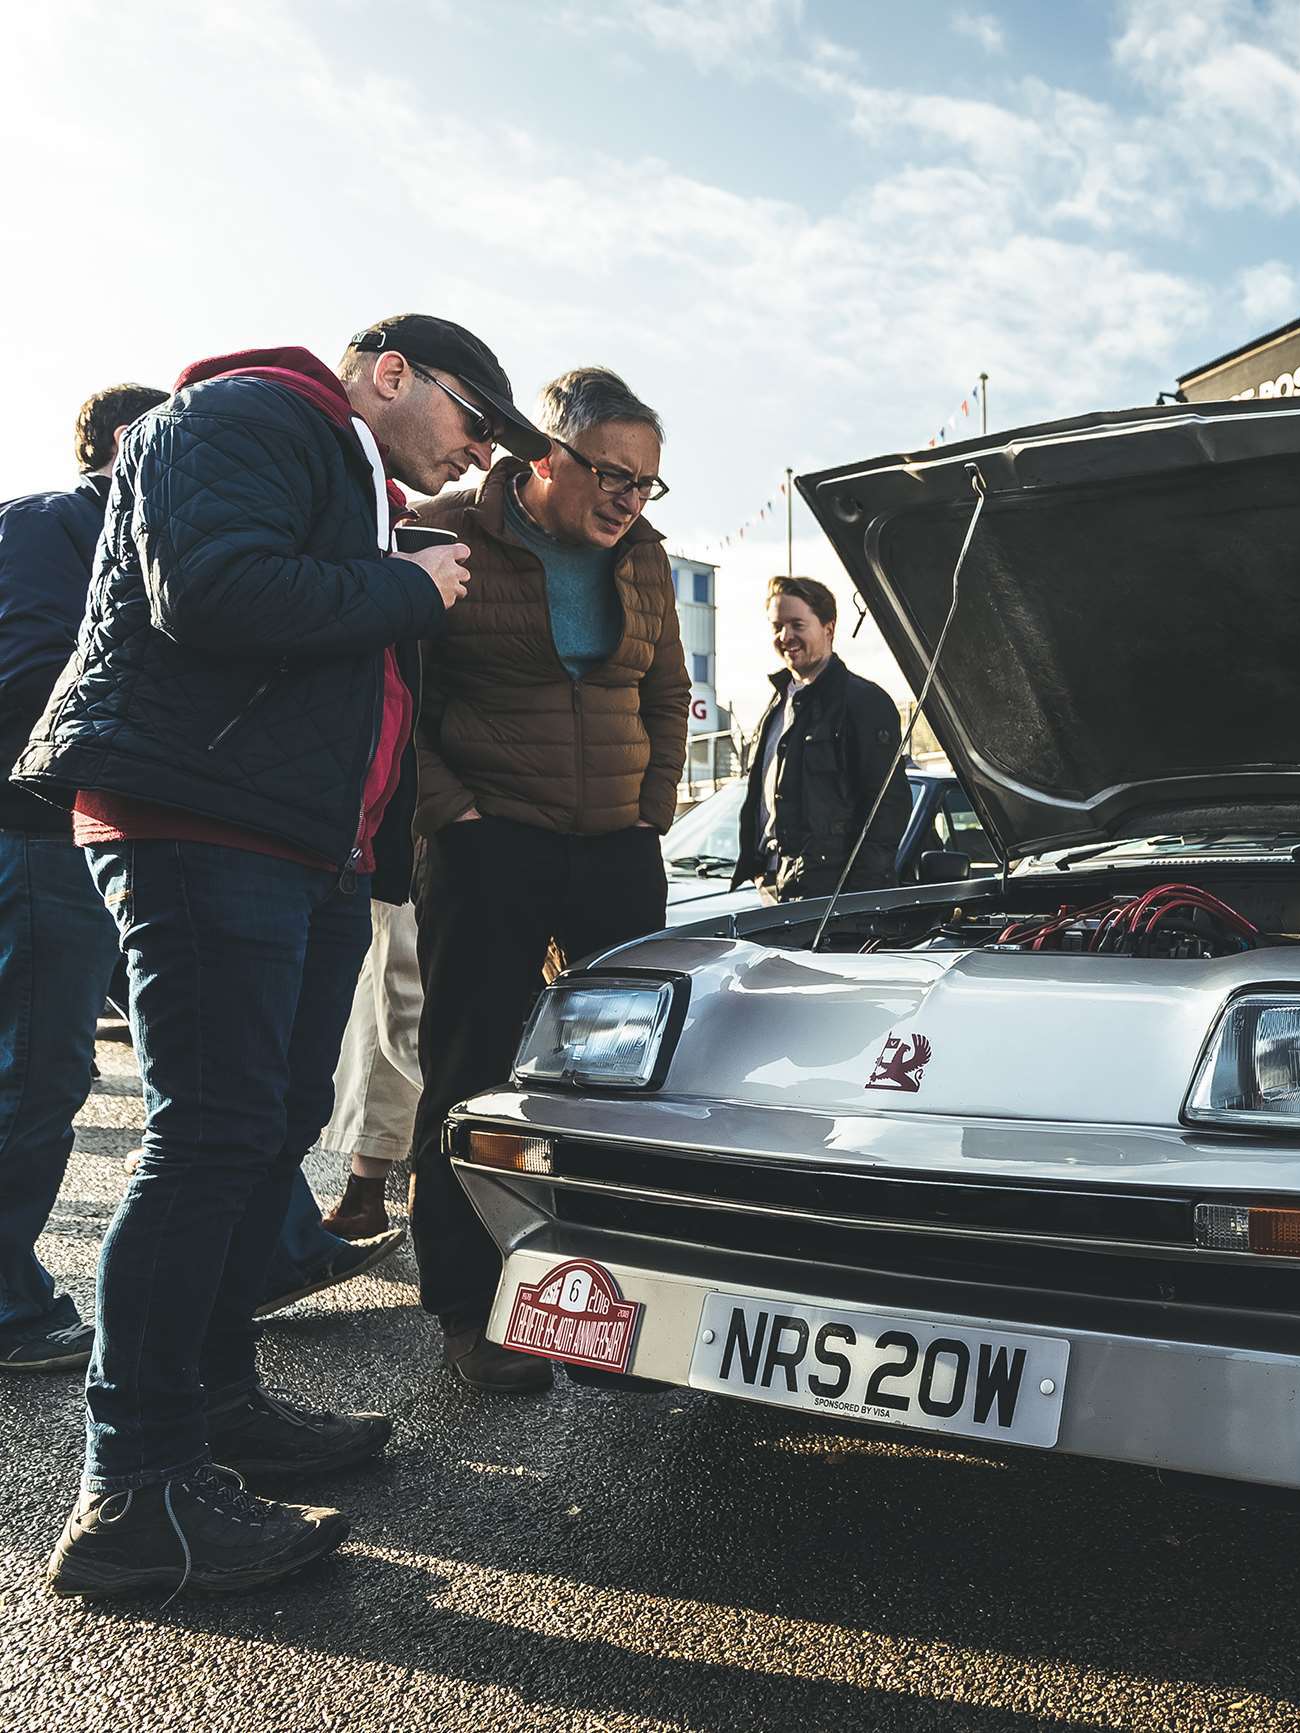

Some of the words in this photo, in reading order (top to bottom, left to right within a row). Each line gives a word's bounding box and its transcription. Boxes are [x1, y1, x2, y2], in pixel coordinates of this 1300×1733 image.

[569, 1279, 582, 1302] 6
[587, 1283, 610, 1315] 2018
[573, 1320, 627, 1362] ANNIVERSARY
[719, 1307, 857, 1399] NRS
[864, 1329, 1029, 1429] 20W
[814, 1398, 860, 1413] SPONSORED
[860, 1405, 872, 1415] BY
[873, 1407, 891, 1418] VISA
